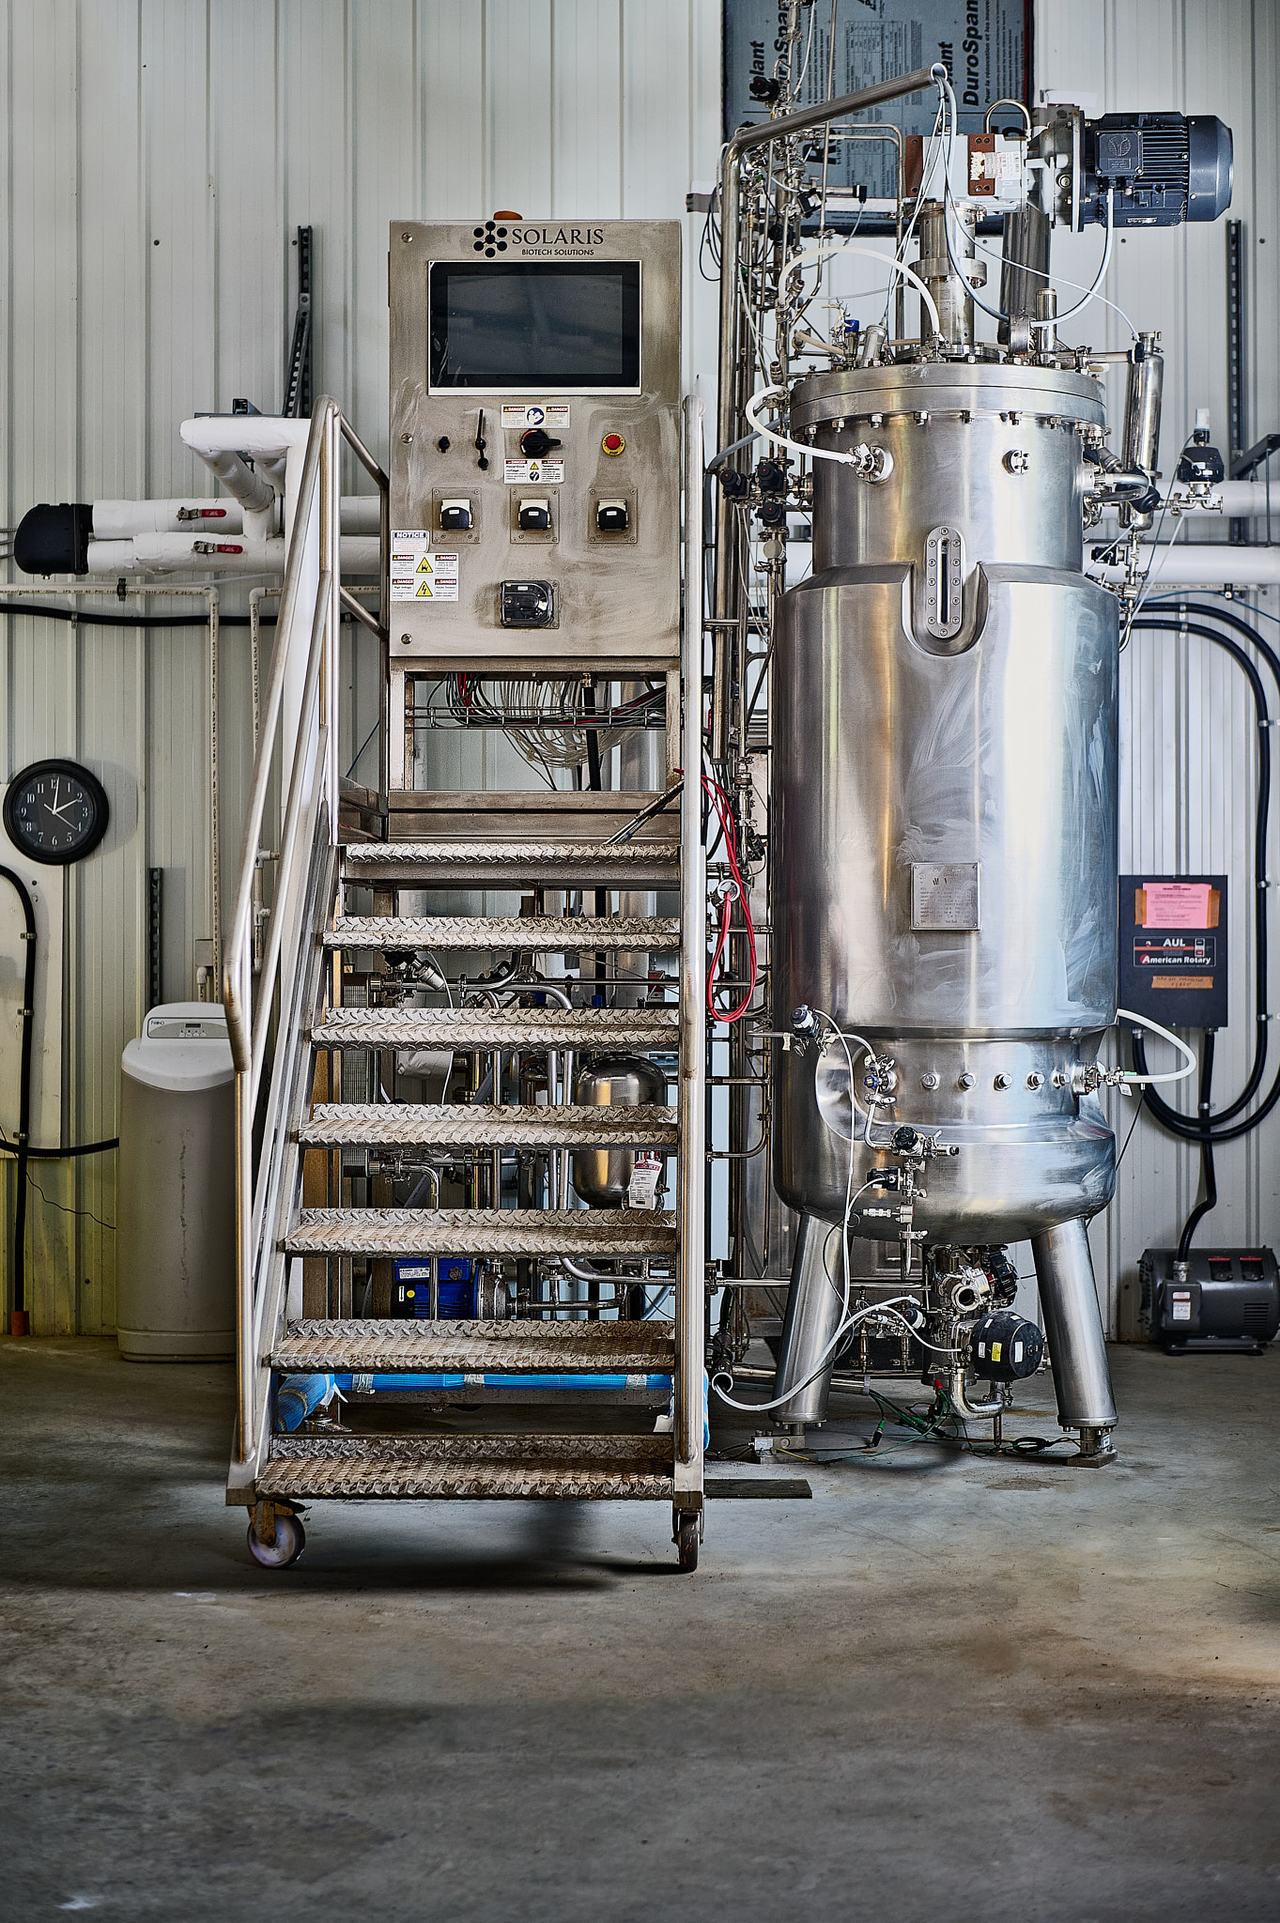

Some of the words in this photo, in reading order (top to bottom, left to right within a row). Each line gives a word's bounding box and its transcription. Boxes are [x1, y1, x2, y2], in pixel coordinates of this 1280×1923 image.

[962, 0, 982, 106] DuroSpan
[512, 228, 604, 245] SOLARIS
[521, 248, 553, 256] BIOTECH
[554, 248, 595, 256] SOLUTIONS
[37, 783, 44, 794] 11
[67, 782, 71, 793] 1
[26, 793, 35, 804] 10
[76, 792, 83, 803] 2
[21, 807, 27, 817] 9
[82, 807, 88, 817] 3
[26, 822, 32, 832] 8
[38, 831, 44, 843] 7
[51, 835, 58, 846] 6
[66, 832, 72, 842] 5
[1163, 938, 1186, 947] AUL
[1141, 955, 1183, 964] American
[1183, 956, 1211, 965] Rotary
